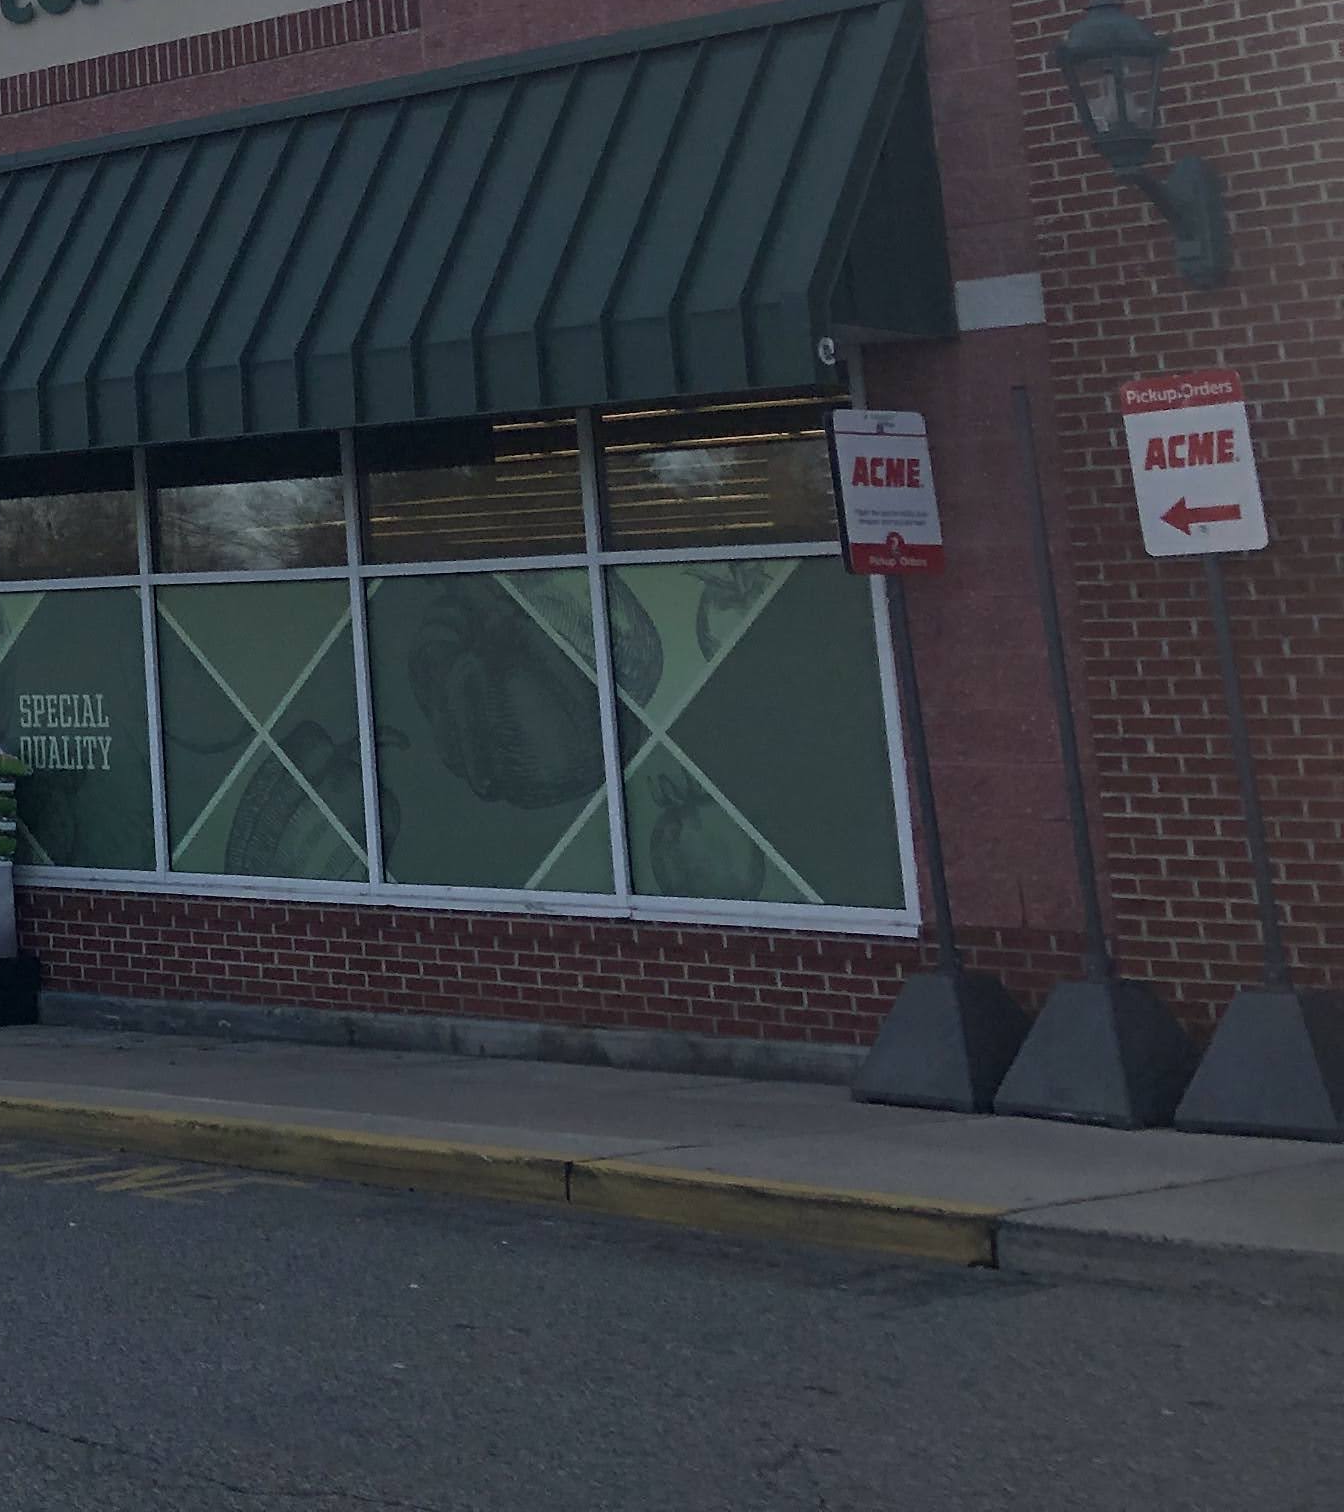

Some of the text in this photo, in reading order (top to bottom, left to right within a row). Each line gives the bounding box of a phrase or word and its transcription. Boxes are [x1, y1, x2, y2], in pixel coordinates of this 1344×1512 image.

[1126, 381, 1233, 405] Pickup Orders
[1144, 429, 1234, 471] ACME
[852, 456, 921, 488] ACME
[19, 693, 110, 728] SPECIAL
[19, 735, 113, 775] QUALITY
